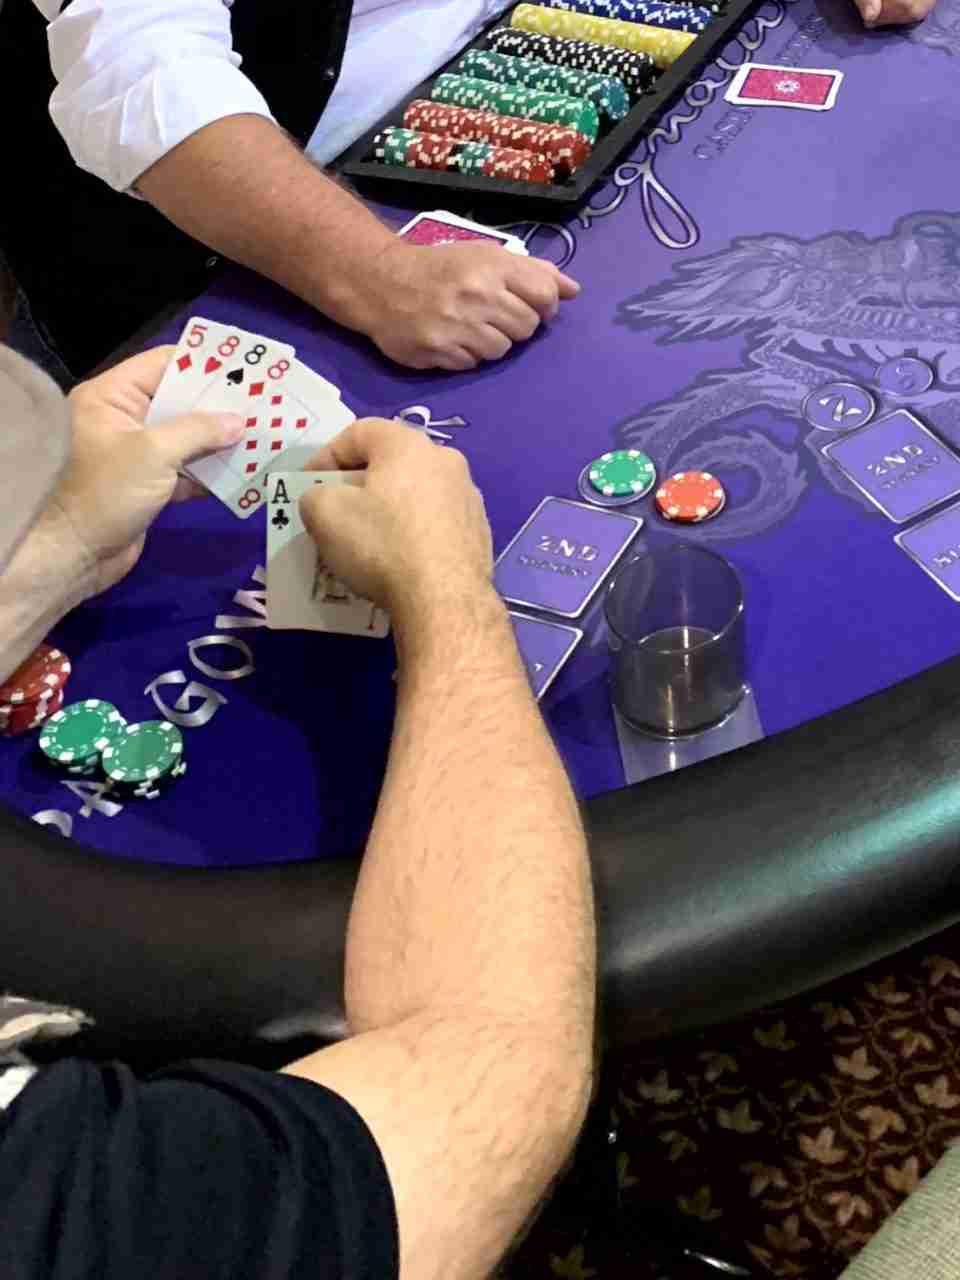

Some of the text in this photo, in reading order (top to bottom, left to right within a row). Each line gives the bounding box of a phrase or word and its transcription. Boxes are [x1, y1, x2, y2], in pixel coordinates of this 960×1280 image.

[186, 323, 209, 350] 5
[217, 334, 241, 357] 8
[244, 343, 267, 366] 8
[266, 358, 291, 381] 8
[865, 444, 924, 476] 2ND
[271, 477, 291, 505] A
[536, 534, 601, 562] 2ND
